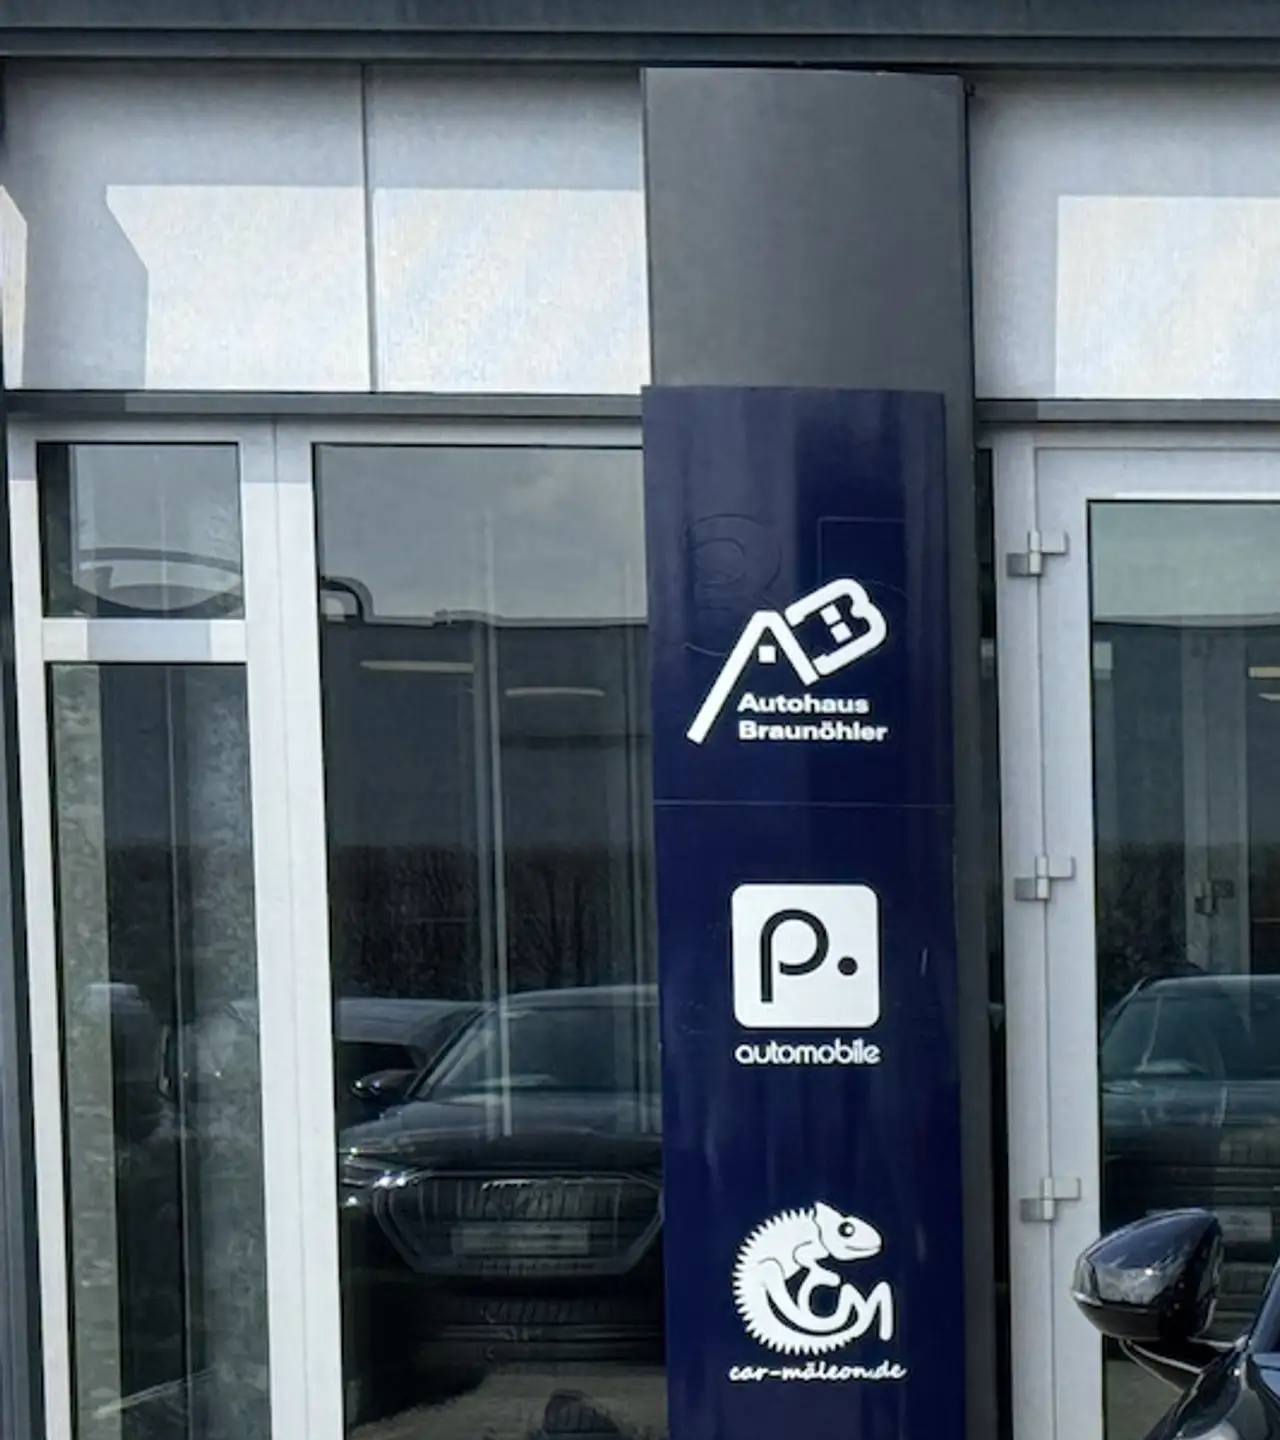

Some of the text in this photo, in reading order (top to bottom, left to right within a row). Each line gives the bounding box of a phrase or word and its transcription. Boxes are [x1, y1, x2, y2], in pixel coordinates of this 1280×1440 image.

[737, 693, 869, 714] Autohaus
[738, 720, 888, 741] Braunöhler
[735, 1038, 881, 1065] automobile
